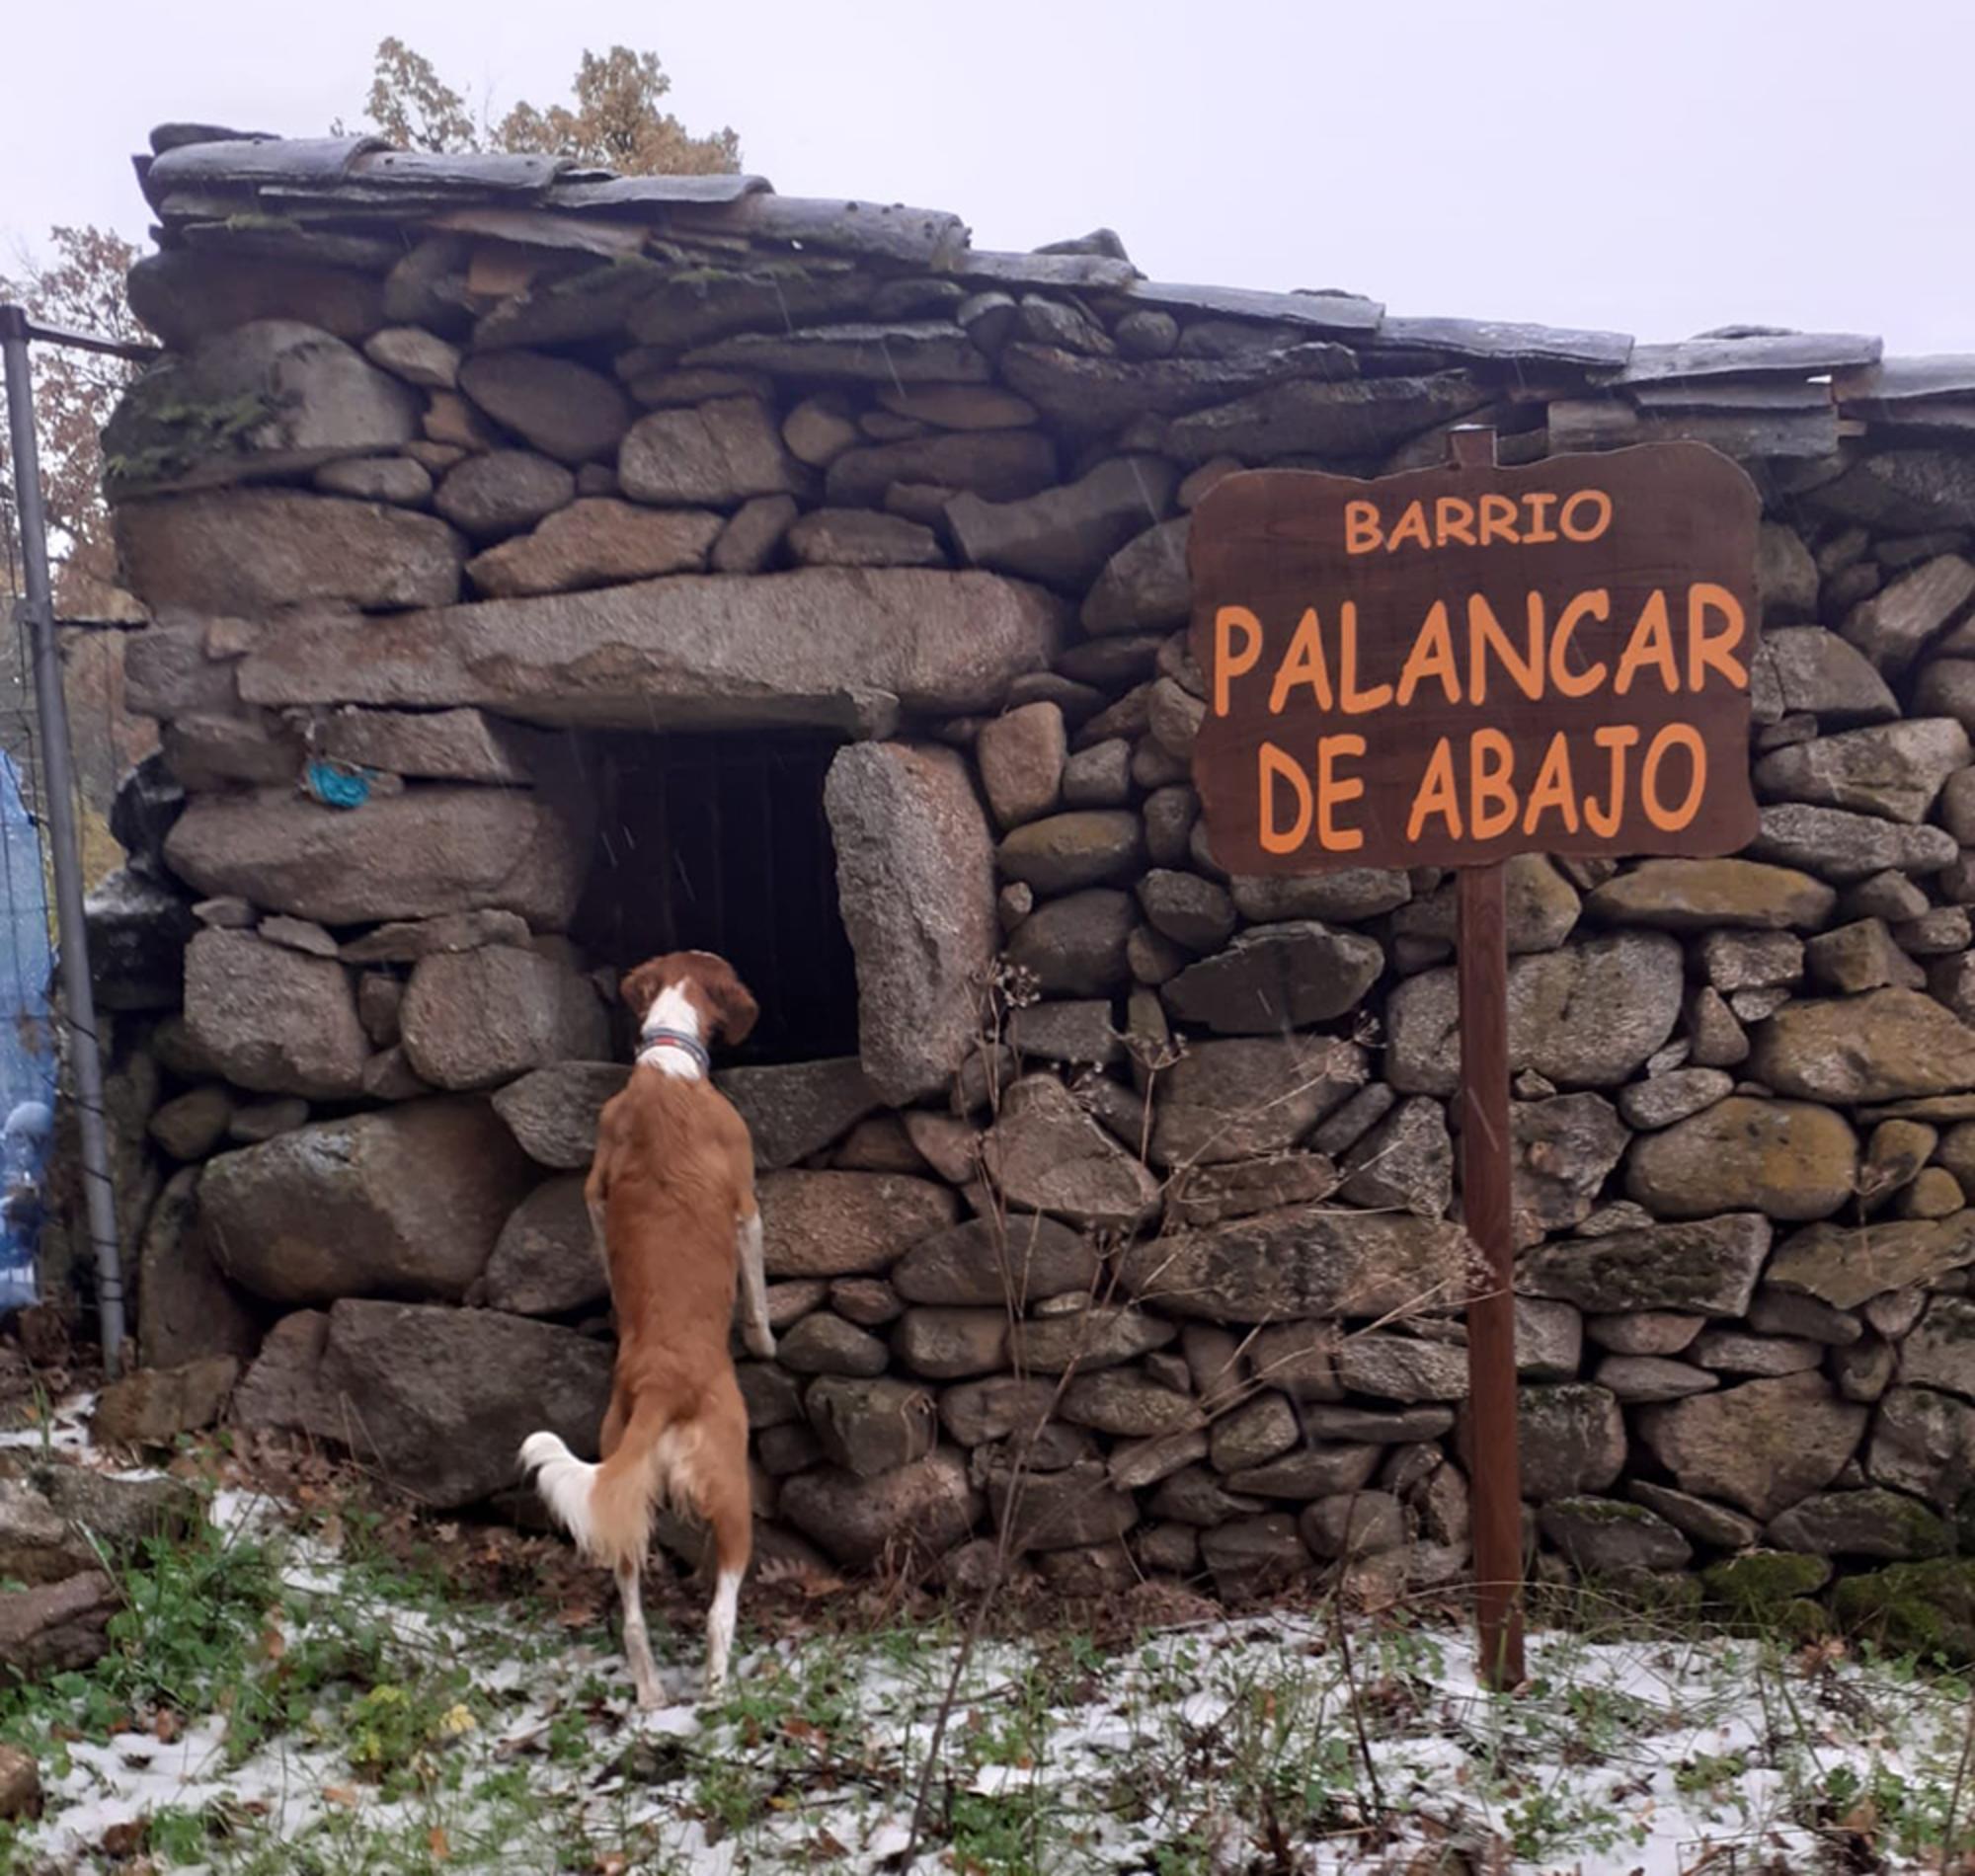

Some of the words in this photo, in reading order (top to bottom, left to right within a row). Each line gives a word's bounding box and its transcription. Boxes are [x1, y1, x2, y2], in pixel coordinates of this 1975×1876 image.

[1345, 490, 1612, 554] BARRIO
[1215, 583, 1749, 717] PALANCAR
[1258, 734, 1367, 855] DE
[1406, 722, 1707, 842] ABAJO
